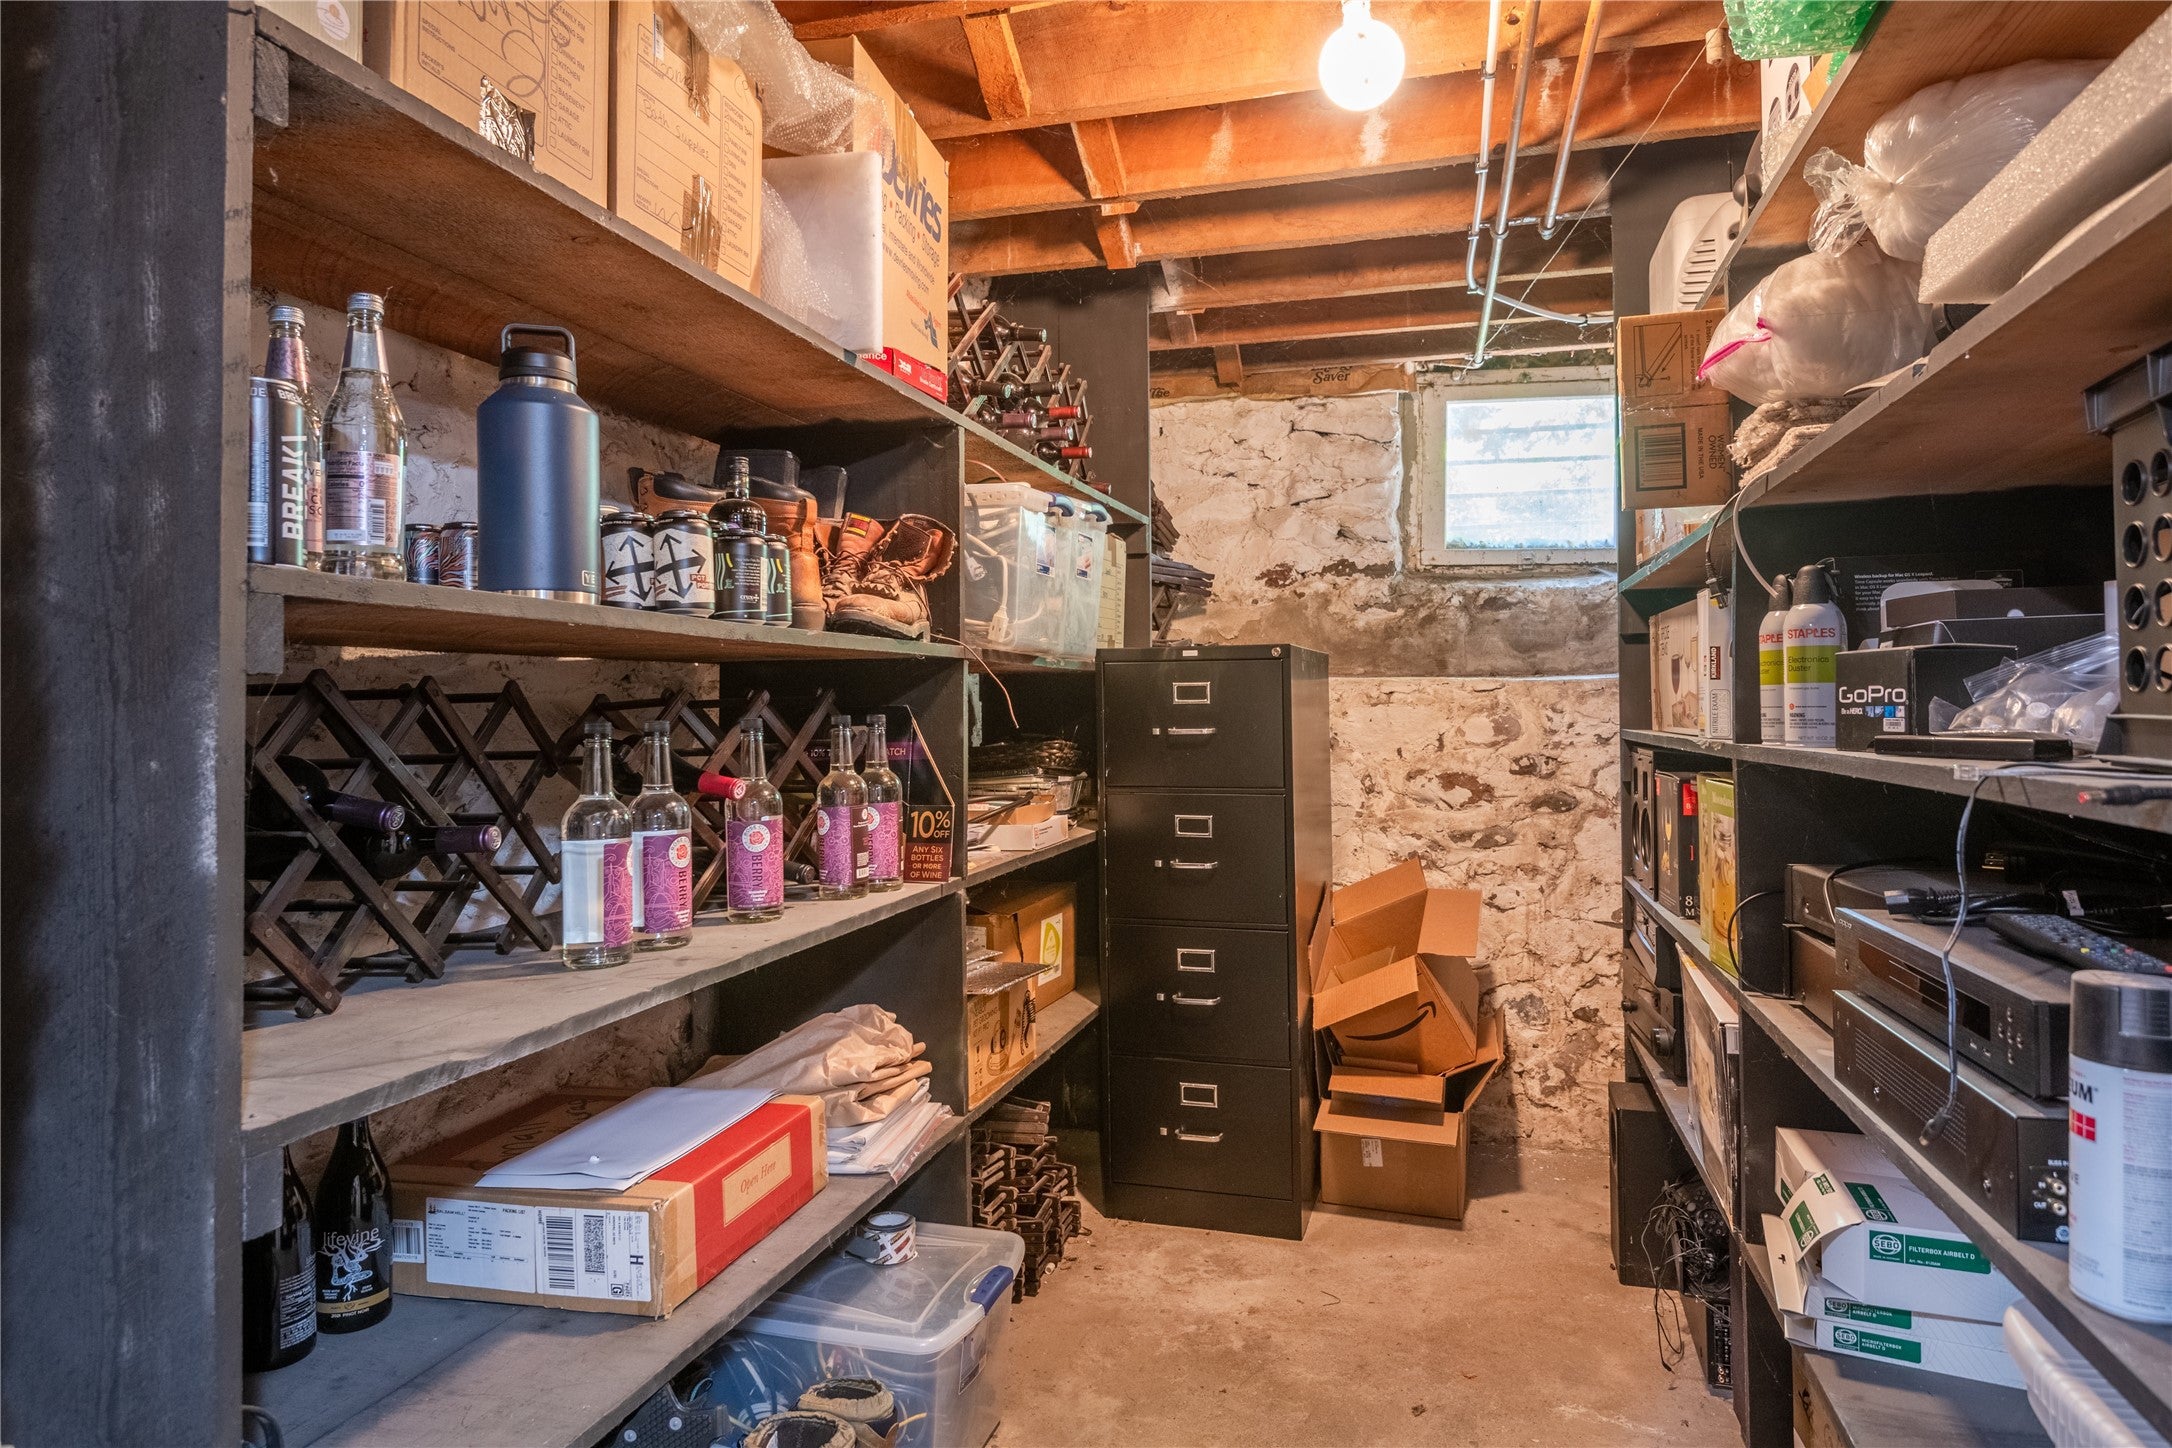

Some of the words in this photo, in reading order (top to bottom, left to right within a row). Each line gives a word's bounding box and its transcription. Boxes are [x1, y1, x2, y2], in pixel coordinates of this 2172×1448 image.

[895, 202, 916, 244] Packing
[922, 233, 940, 268] Storage
[1312, 371, 1351, 384] Saver
[1708, 434, 1717, 470] OWNED
[1787, 628, 1836, 640] STAPLES
[1788, 656, 1830, 664] Electronics
[1788, 664, 1812, 672] Duster
[1839, 685, 1906, 704] GoPro
[911, 810, 951, 838] 10%
[934, 830, 951, 838] OFF
[930, 846, 944, 854] SIX
[910, 854, 944, 862] BOTTLES
[752, 855, 762, 888] BERRY
[678, 870, 688, 908] BERRY
[1685, 896, 1693, 907] 8
[2069, 1078, 2094, 1104] UM
[740, 1175, 758, 1195] Open
[761, 1161, 776, 1179] Here
[323, 1228, 380, 1248] lifevine
[1872, 1240, 1900, 1250] SEBO
[1908, 1246, 1942, 1256] FILTERBOX
[1943, 1250, 1969, 1259] AIRBELT
[630, 1255, 644, 1265] H
[1836, 1332, 1856, 1340] SEBO
[1861, 1338, 1902, 1350] MICROFILTERBOX
[1861, 1342, 1881, 1350] AIRBELT
